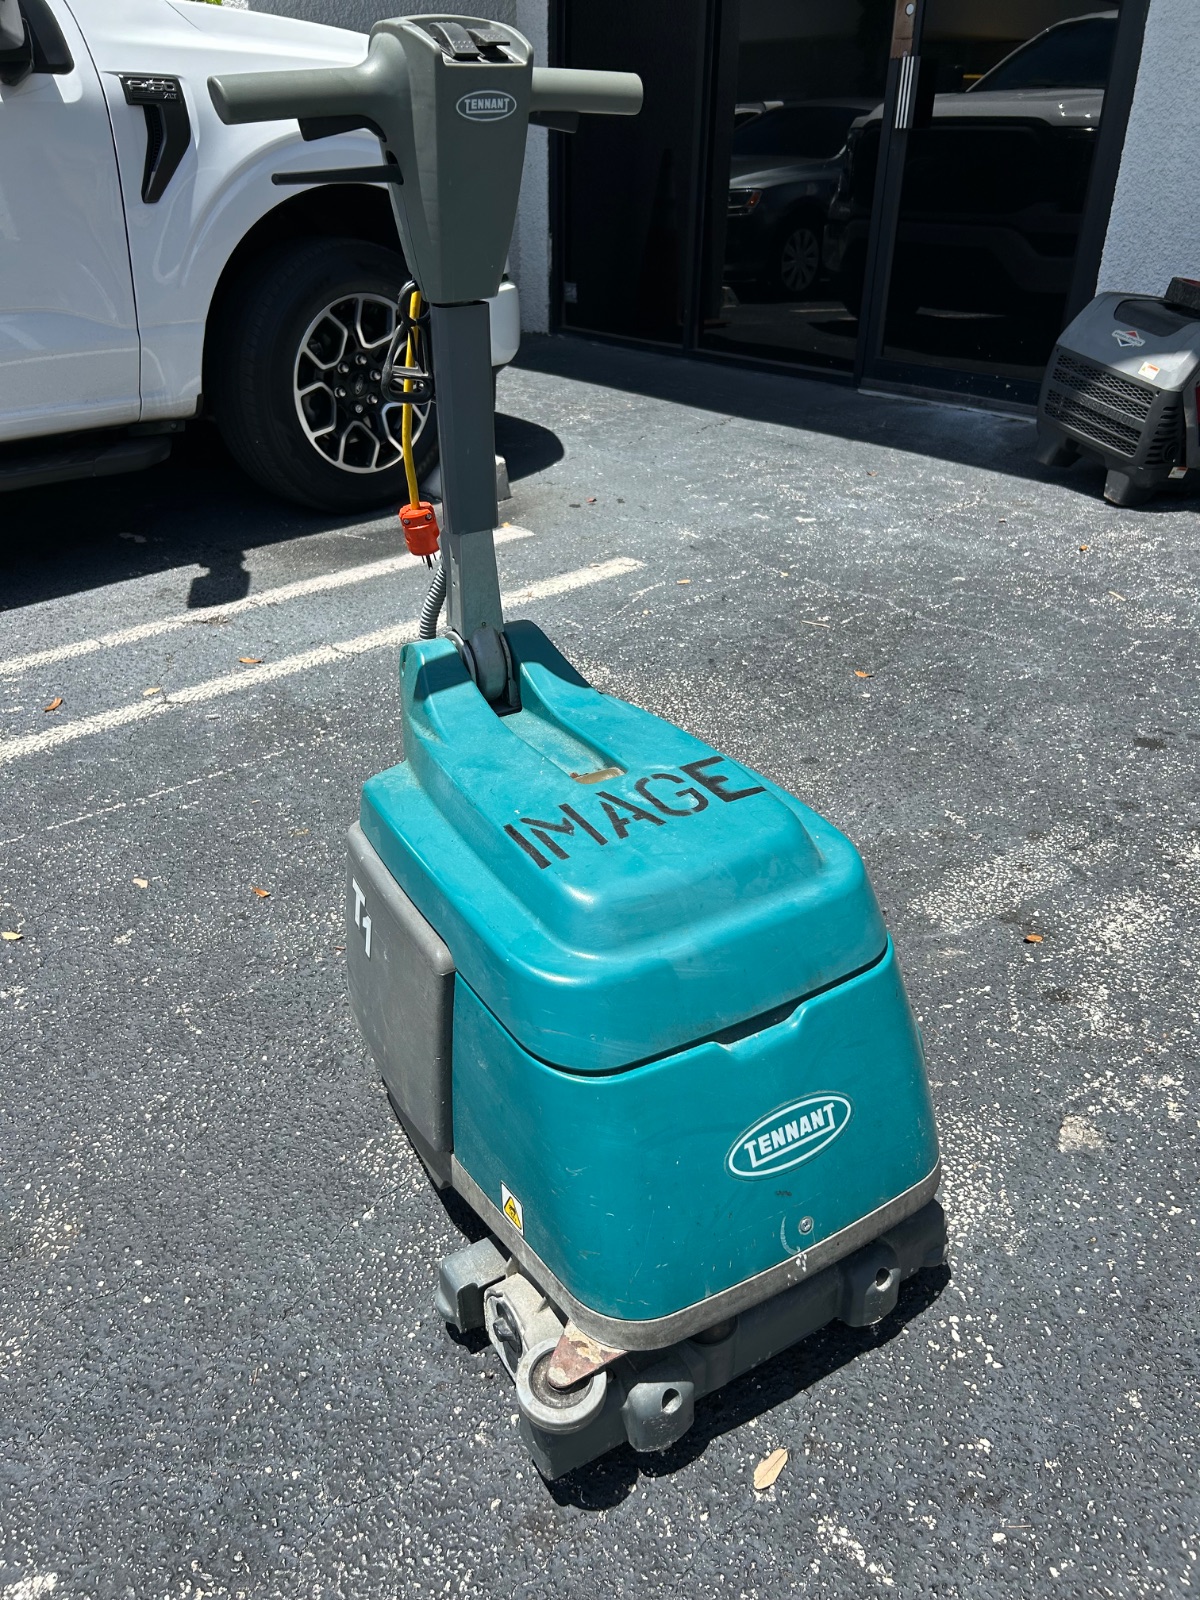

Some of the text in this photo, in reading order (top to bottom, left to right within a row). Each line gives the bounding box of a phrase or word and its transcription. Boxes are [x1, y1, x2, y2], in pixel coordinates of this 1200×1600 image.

[464, 98, 510, 114] TENNANT
[503, 756, 767, 869] IMAGE
[352, 877, 372, 959] T1
[744, 1102, 835, 1168] TENNANT
